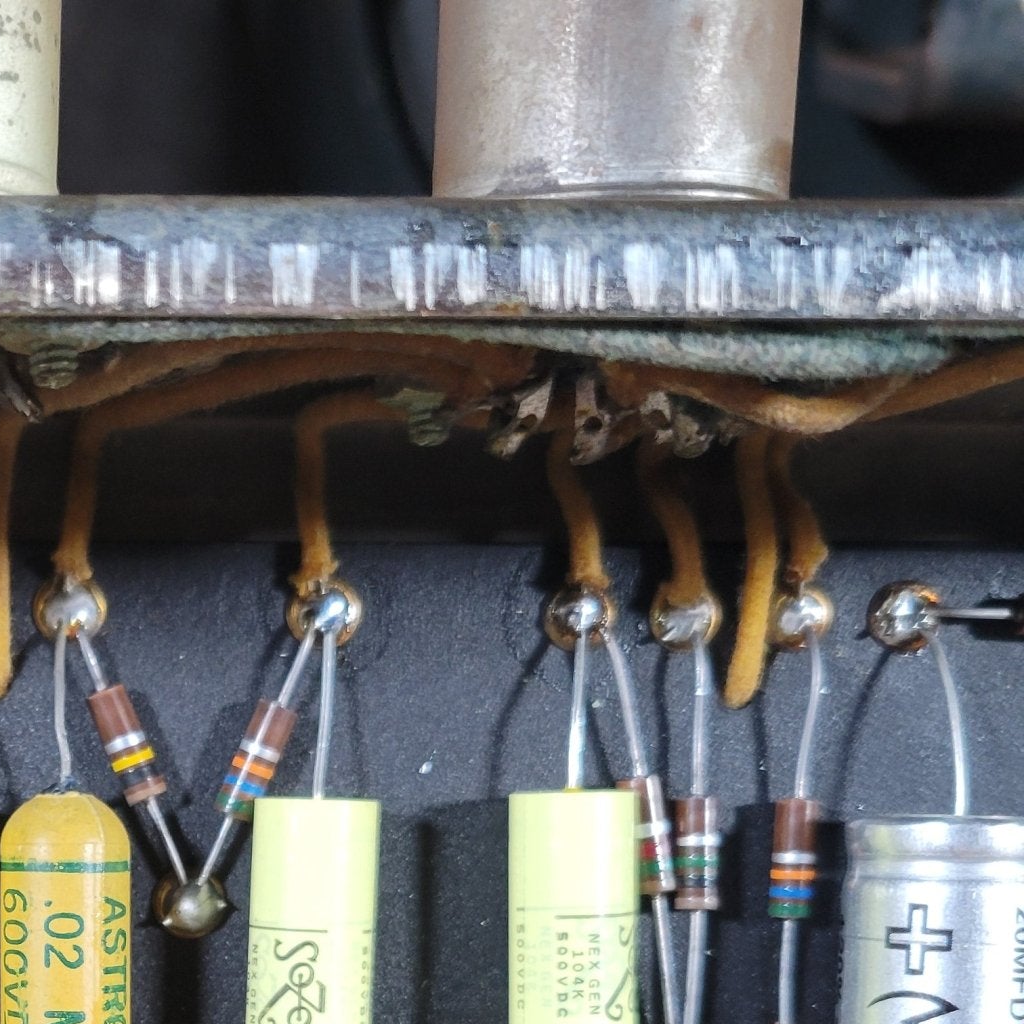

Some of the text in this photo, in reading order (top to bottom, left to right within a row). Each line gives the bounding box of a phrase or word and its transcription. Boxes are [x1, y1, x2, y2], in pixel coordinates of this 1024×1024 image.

[43, 900, 85, 969] .02
[556, 932, 568, 1018] 500VDC
[571, 950, 584, 999] 104K
[588, 933, 600, 1015] NEX GEN
